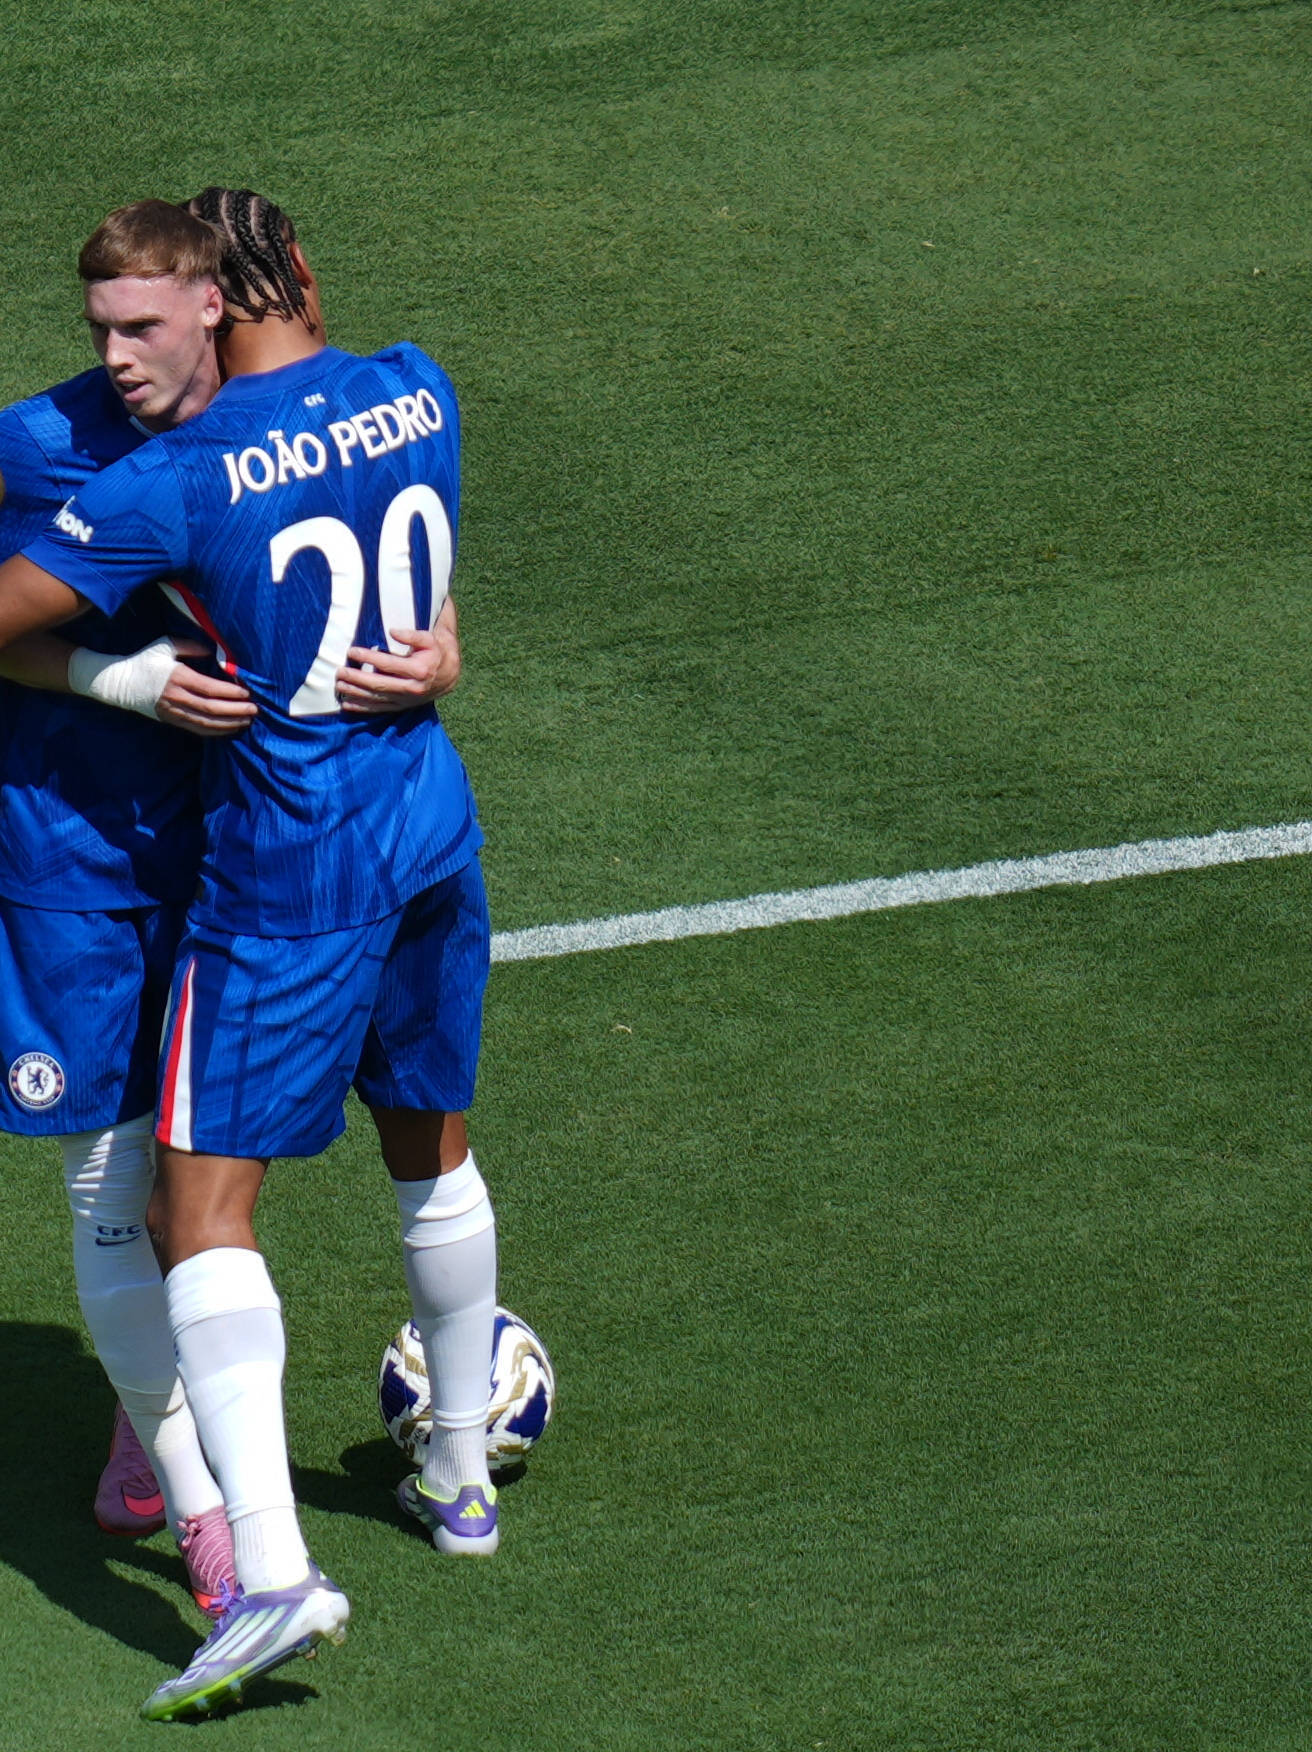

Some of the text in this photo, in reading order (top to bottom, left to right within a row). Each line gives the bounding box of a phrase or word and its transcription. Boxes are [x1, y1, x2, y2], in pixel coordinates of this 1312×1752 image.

[222, 388, 443, 505] JOÃO PEDRO
[269, 483, 452, 717] 20
[18, 1055, 54, 1068] CHELSEA
[97, 1224, 144, 1236] CFC
